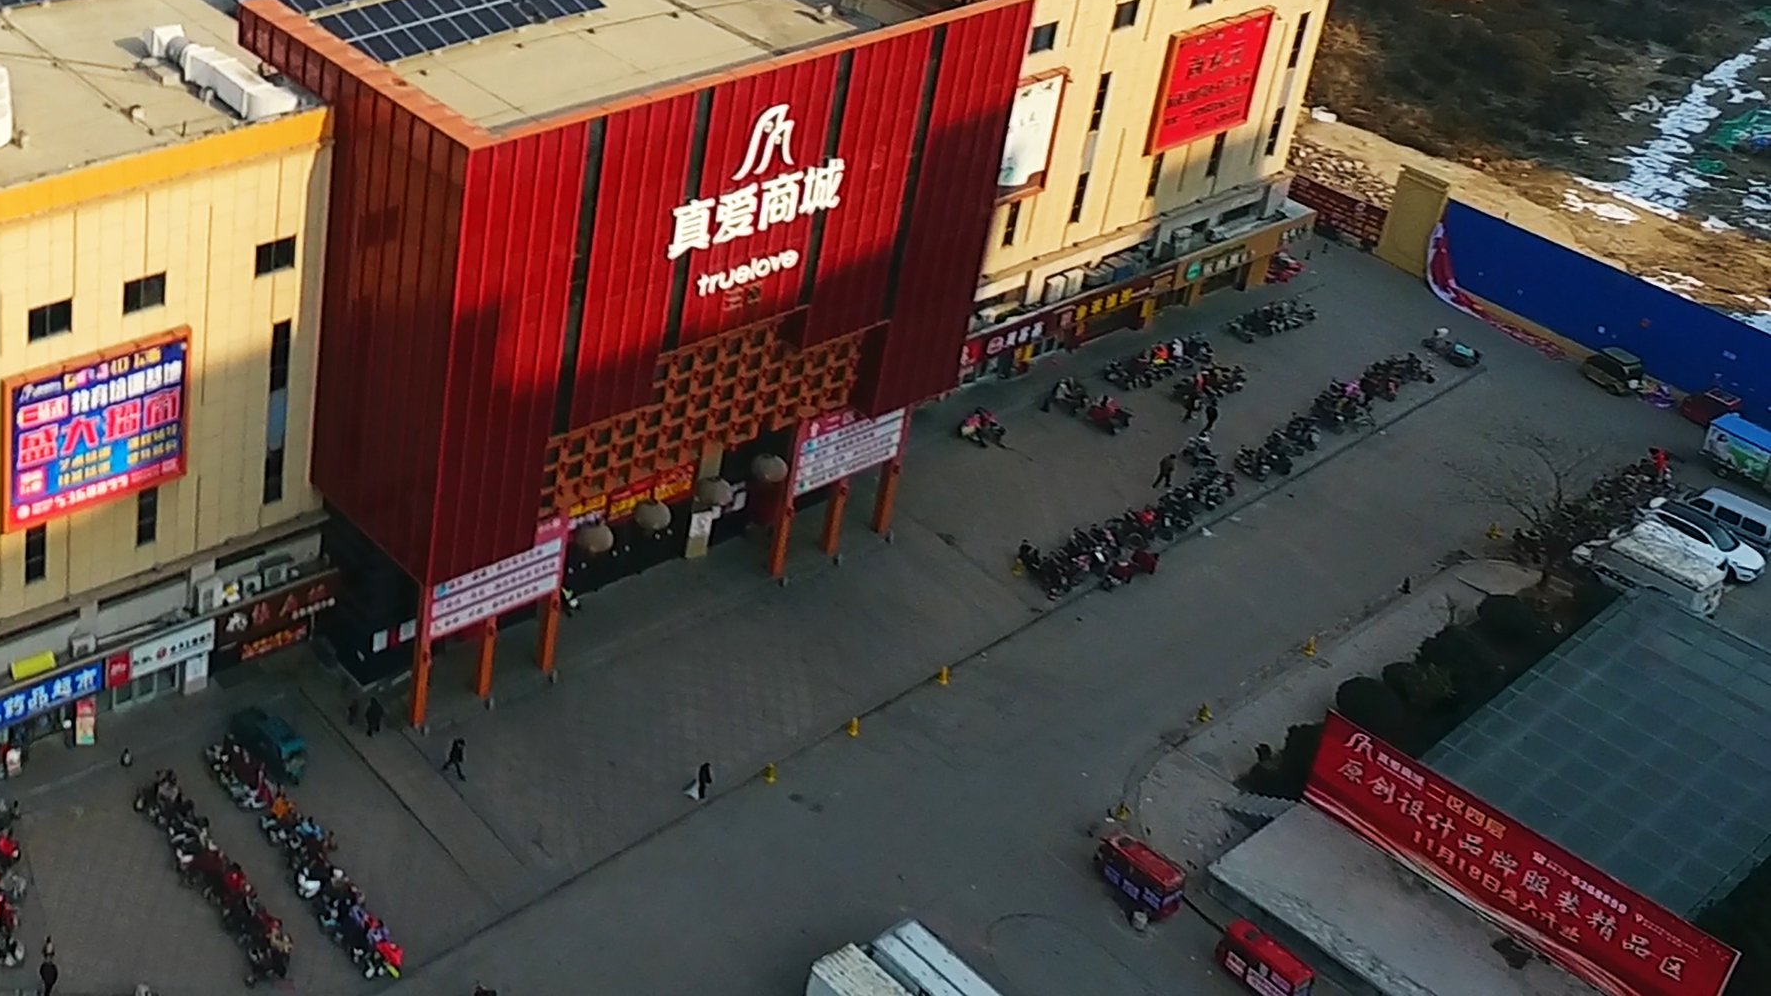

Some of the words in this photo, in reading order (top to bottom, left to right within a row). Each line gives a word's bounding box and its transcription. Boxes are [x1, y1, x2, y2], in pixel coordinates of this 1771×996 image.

[667, 157, 845, 260] 真爱商城
[697, 249, 800, 297] truelove
[16, 386, 182, 470] 盛大招商
[1336, 757, 1688, 983] 原创设计品牌服装精品区
